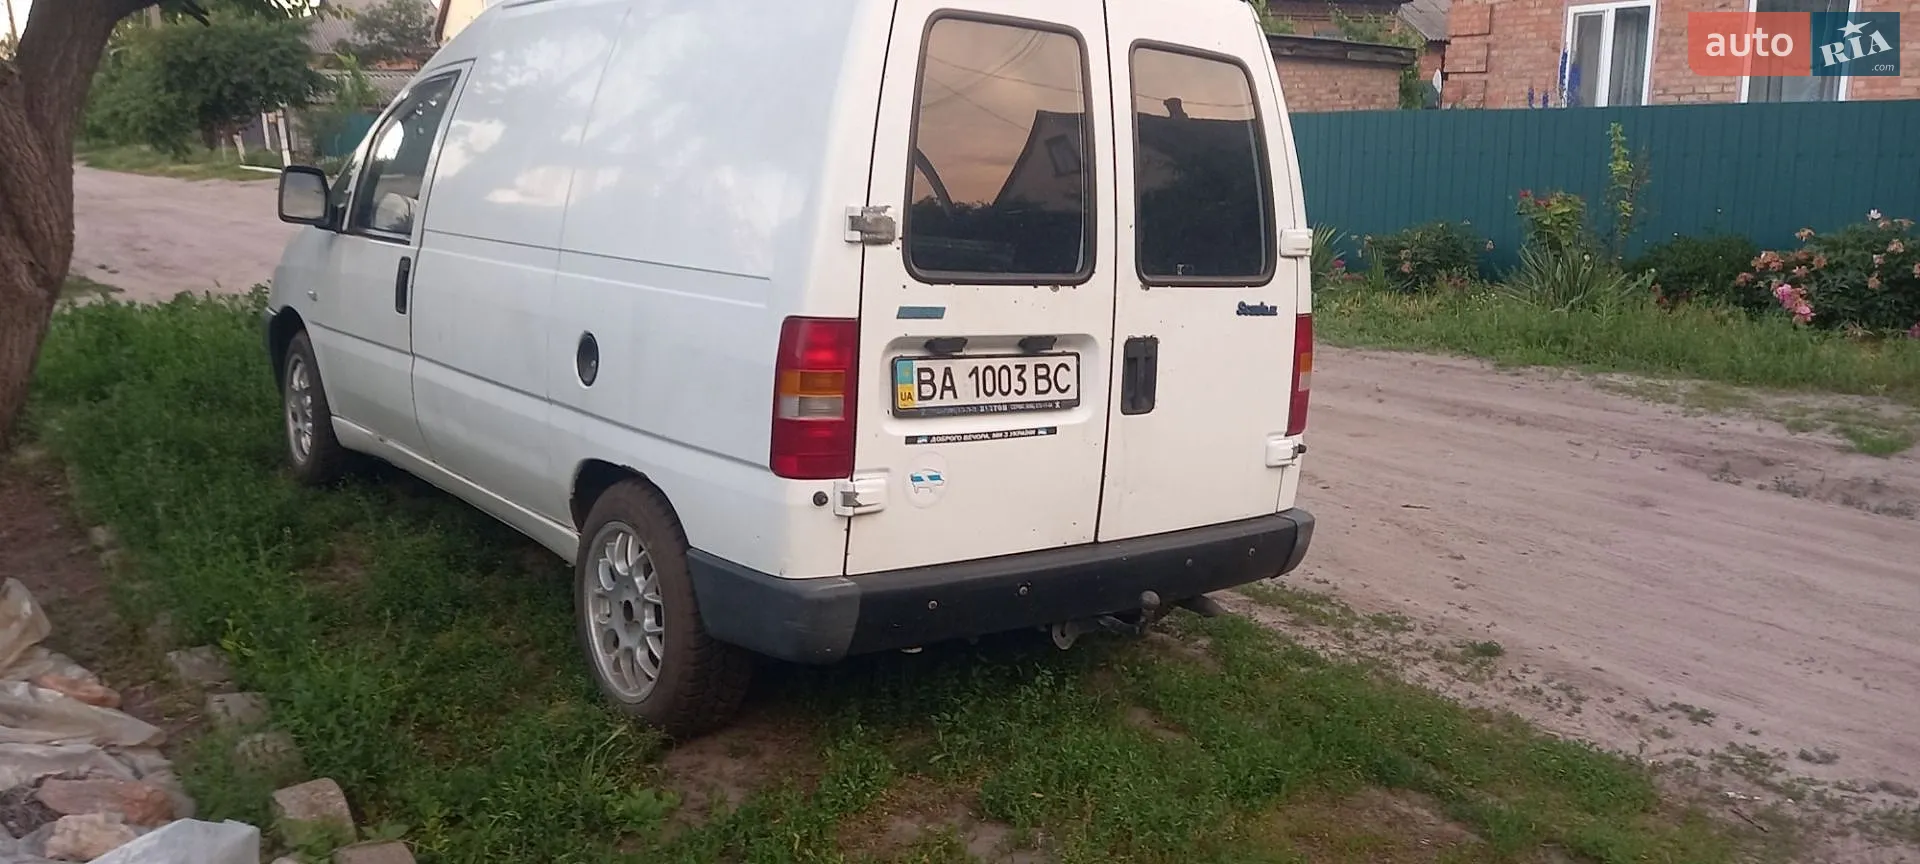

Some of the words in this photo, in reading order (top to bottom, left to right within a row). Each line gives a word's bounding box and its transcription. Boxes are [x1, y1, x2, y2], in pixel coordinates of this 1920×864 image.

[917, 366, 958, 401] BA
[968, 364, 1027, 398] 1003
[1034, 362, 1071, 395] BC
[900, 392, 913, 401] UA
